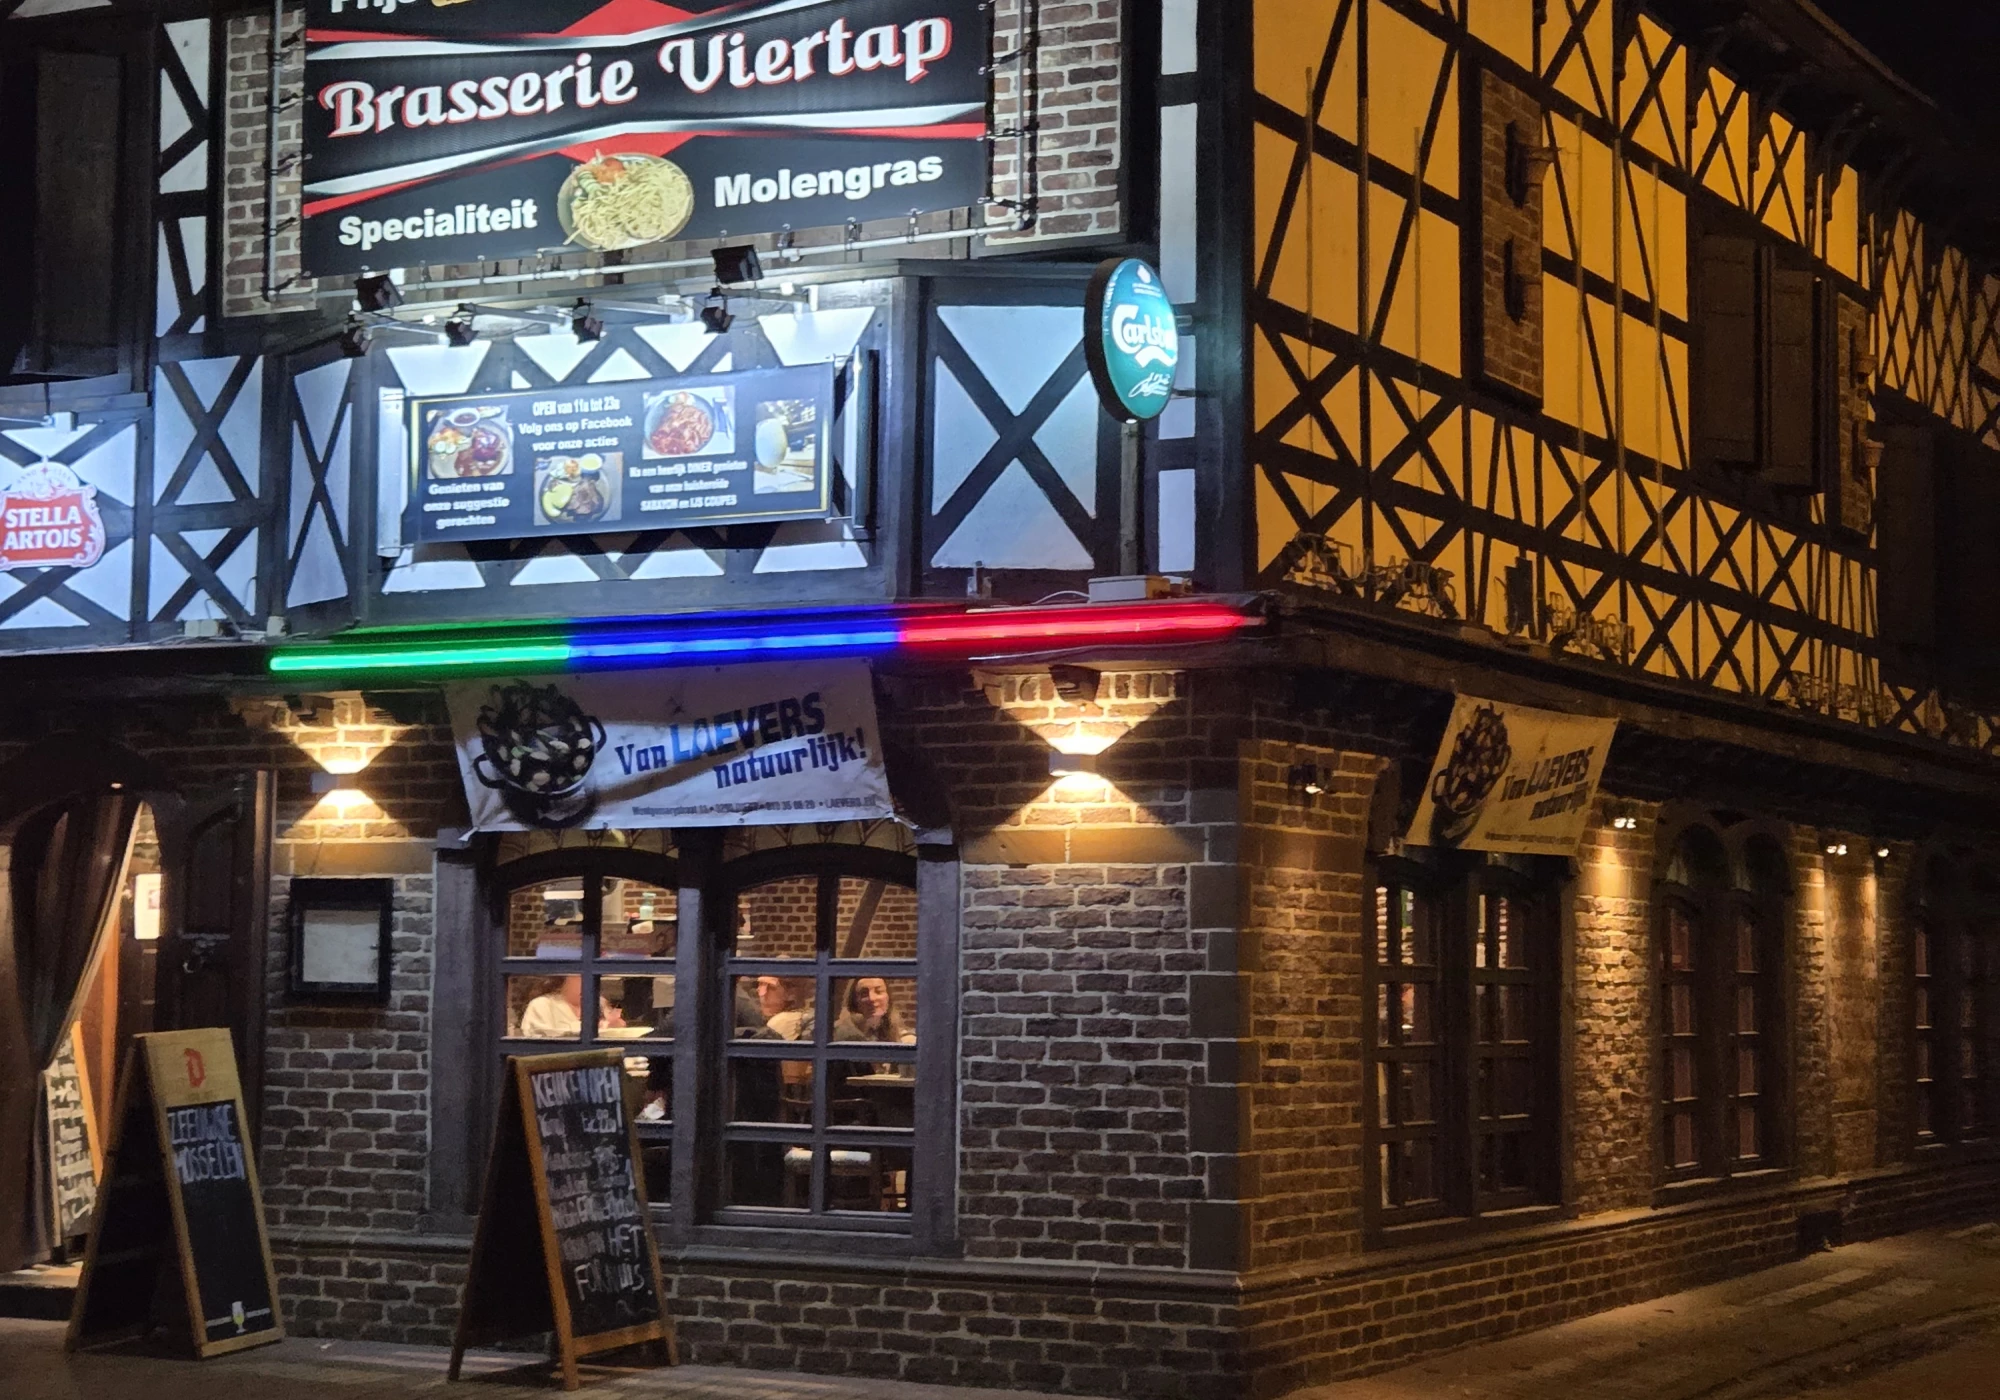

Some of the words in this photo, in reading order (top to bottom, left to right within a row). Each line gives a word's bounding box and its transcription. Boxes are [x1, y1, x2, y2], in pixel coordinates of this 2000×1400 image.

[319, 52, 638, 138] Brasserie
[657, 16, 952, 93] Viertap
[714, 155, 944, 208] Molengras
[338, 198, 538, 251] Specialiteit
[532, 400, 557, 417] OPEN
[557, 402, 573, 415] van
[518, 422, 543, 436] Volg
[544, 422, 564, 433] ons
[565, 421, 579, 433] op
[581, 415, 633, 430] Facebook
[532, 441, 556, 451] voor
[557, 439, 583, 450] onze
[584, 436, 619, 448] acties
[428, 482, 481, 495] Genieten
[482, 481, 505, 492] van
[4, 505, 83, 528] STELLA
[423, 501, 452, 512] onze
[452, 496, 510, 512] suggestie
[435, 515, 496, 530] gerechten
[3, 527, 83, 550] ARTOIS
[614, 743, 667, 775] Van
[669, 692, 826, 764] LAEVERS
[713, 727, 868, 789] natuurlijk!
[531, 1069, 589, 1109] KEUKEN
[588, 1066, 621, 1104] OPEN
[173, 1142, 246, 1184] MOSSELEN
[606, 1223, 643, 1258] HET
